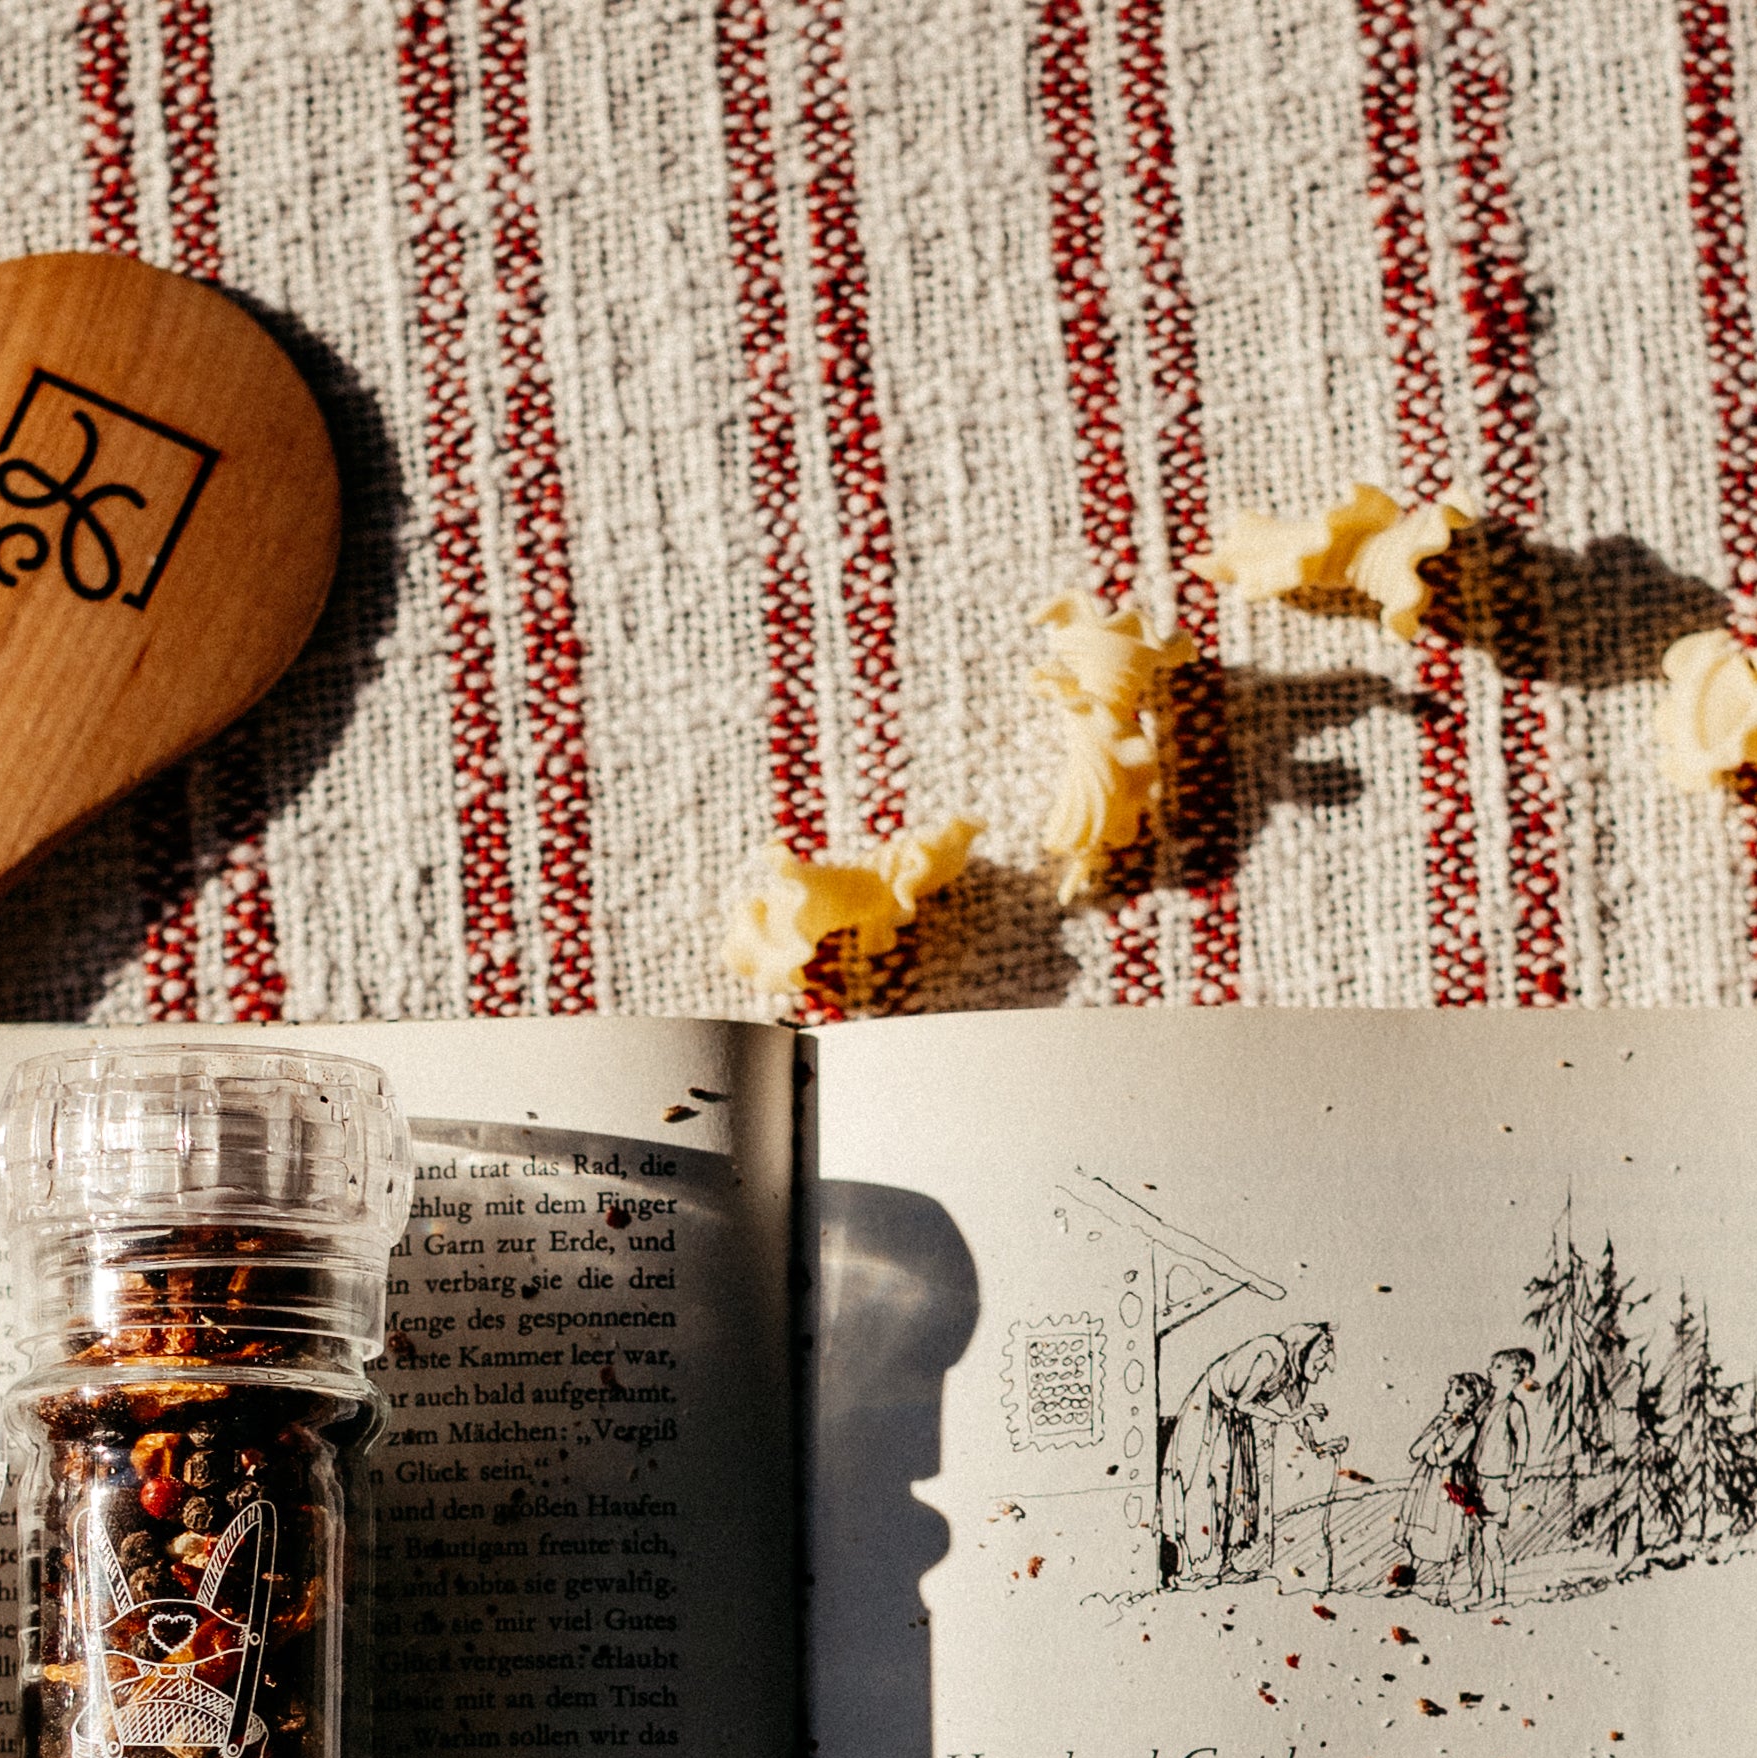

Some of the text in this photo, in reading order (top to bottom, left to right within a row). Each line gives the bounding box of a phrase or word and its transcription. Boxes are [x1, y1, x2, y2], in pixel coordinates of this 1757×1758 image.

[470, 1160, 510, 1178] trat
[524, 1155, 558, 1177] das
[640, 1154, 676, 1176] die
[485, 1194, 525, 1215] mit
[535, 1192, 587, 1214] dem
[423, 1232, 485, 1254] Garn
[497, 1238, 536, 1253] zur
[628, 1230, 676, 1252] und
[425, 1271, 516, 1300] verbarg
[577, 1268, 614, 1290] die
[629, 1267, 675, 1289] drei
[467, 1307, 505, 1329] des
[518, 1312, 677, 1335] gesponnenen
[458, 1345, 564, 1367] Kammer
[570, 1344, 615, 1366] leer
[415, 1382, 525, 1406] auch bald
